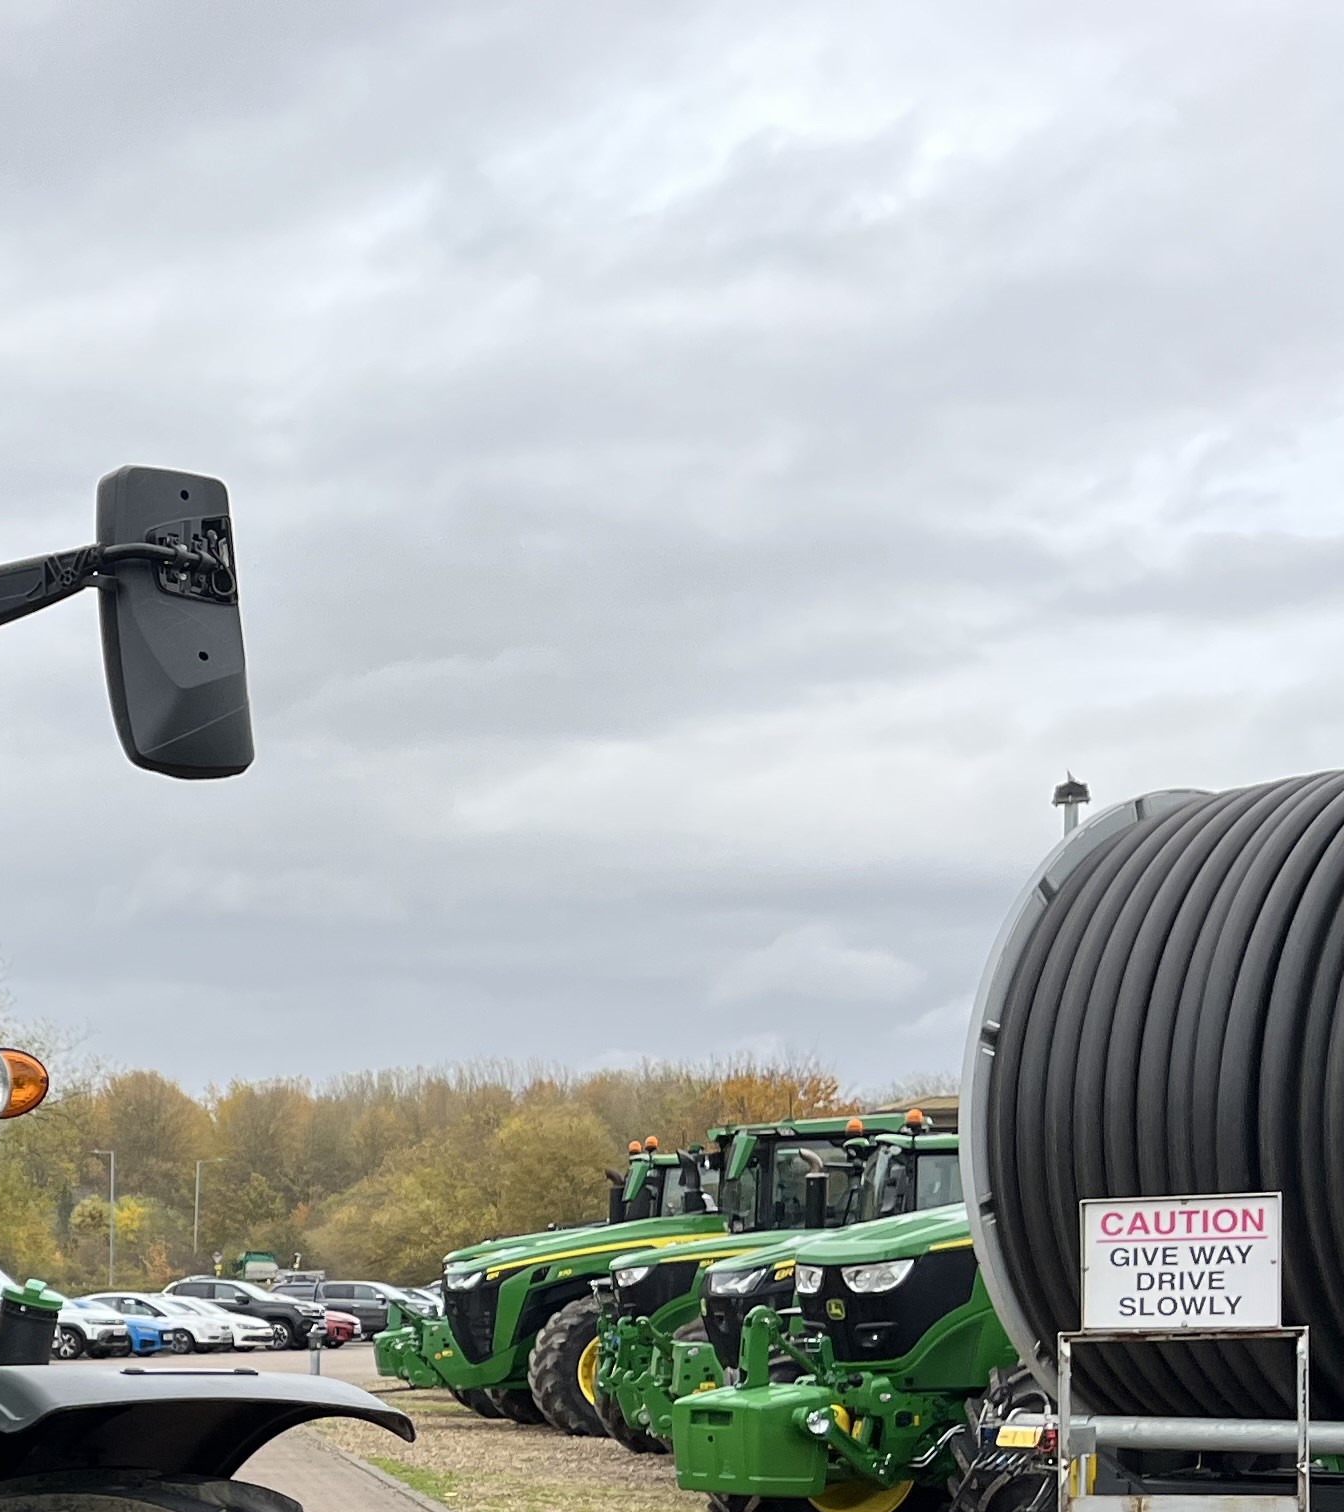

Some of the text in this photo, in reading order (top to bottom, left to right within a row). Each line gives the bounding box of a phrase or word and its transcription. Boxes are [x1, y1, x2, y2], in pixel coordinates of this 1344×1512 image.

[1099, 1206, 1265, 1237] CAUTION
[1109, 1244, 1254, 1267] GIVE WAY
[1136, 1270, 1226, 1292] DRIVE
[1118, 1294, 1243, 1317] SLOWLY
